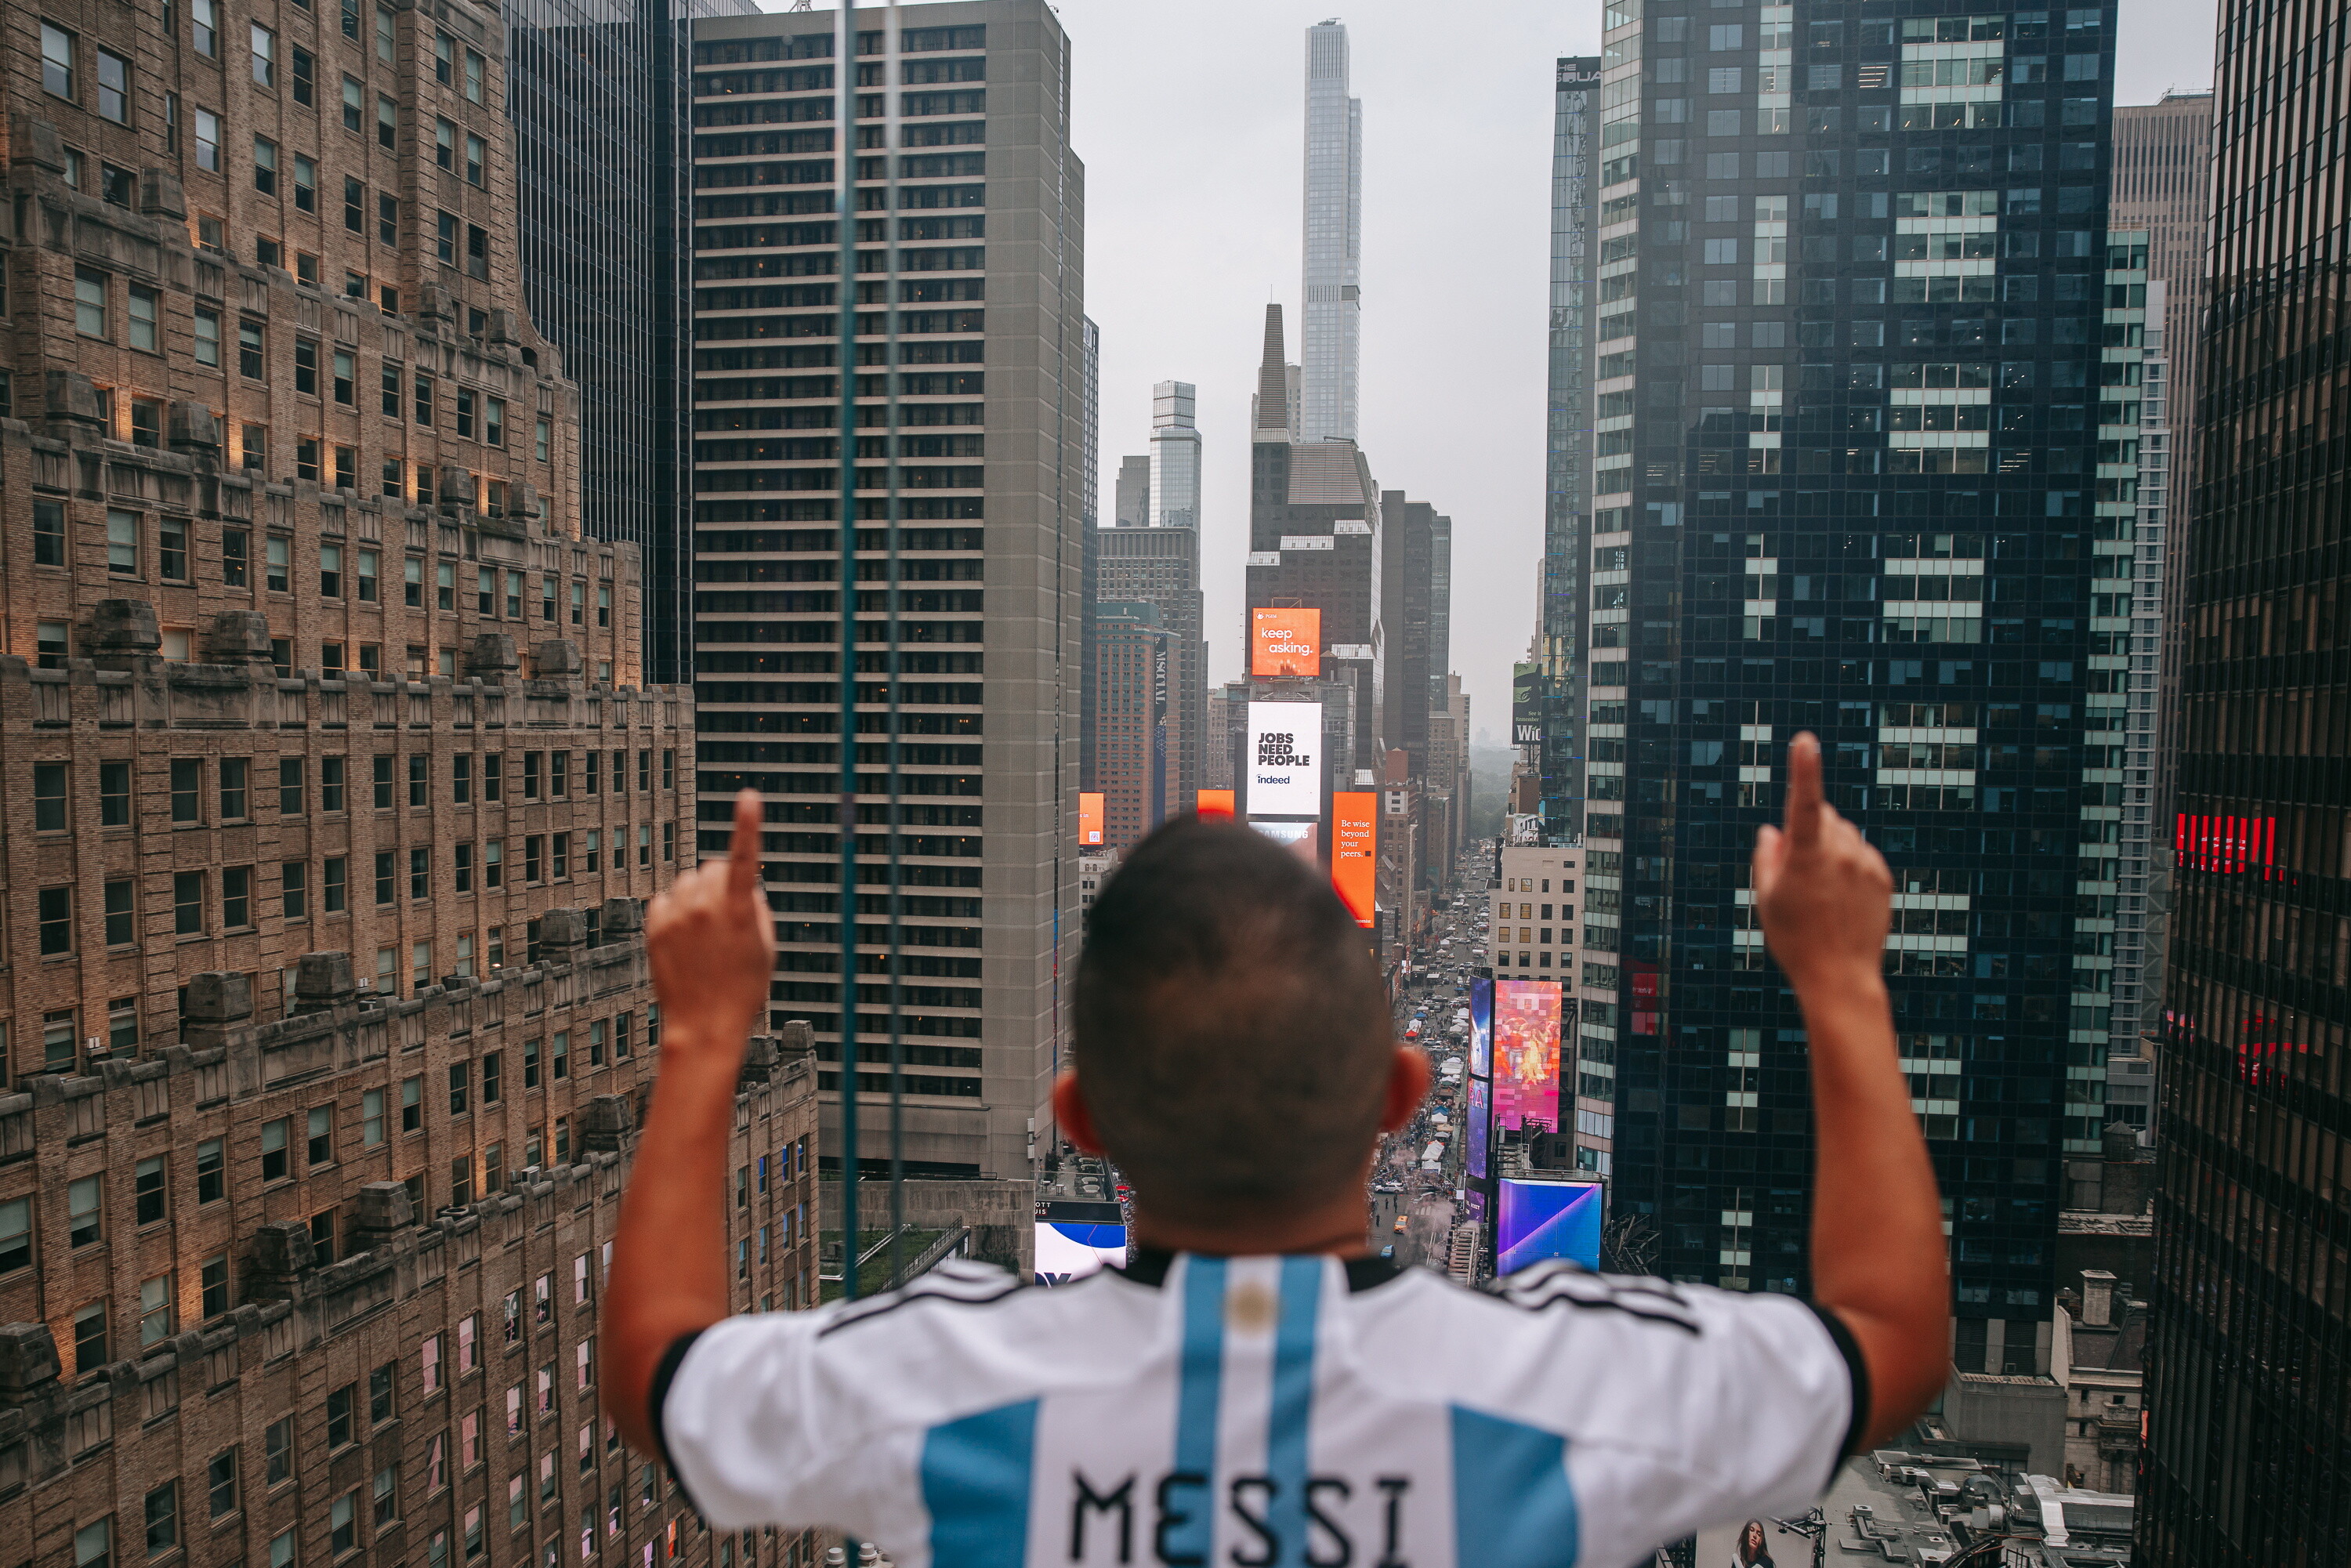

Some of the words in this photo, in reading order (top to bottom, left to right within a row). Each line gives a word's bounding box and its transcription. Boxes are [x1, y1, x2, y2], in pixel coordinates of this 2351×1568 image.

[1261, 627, 1293, 641] keep
[1269, 642, 1313, 656] asking.
[1258, 733, 1294, 744] JOBS
[1258, 744, 1293, 755] NEED
[1258, 755, 1310, 766] PEOPLE
[1257, 774, 1290, 784] indeed
[1341, 829, 1370, 838] beyond
[1071, 1468, 1411, 1568] MESSI
